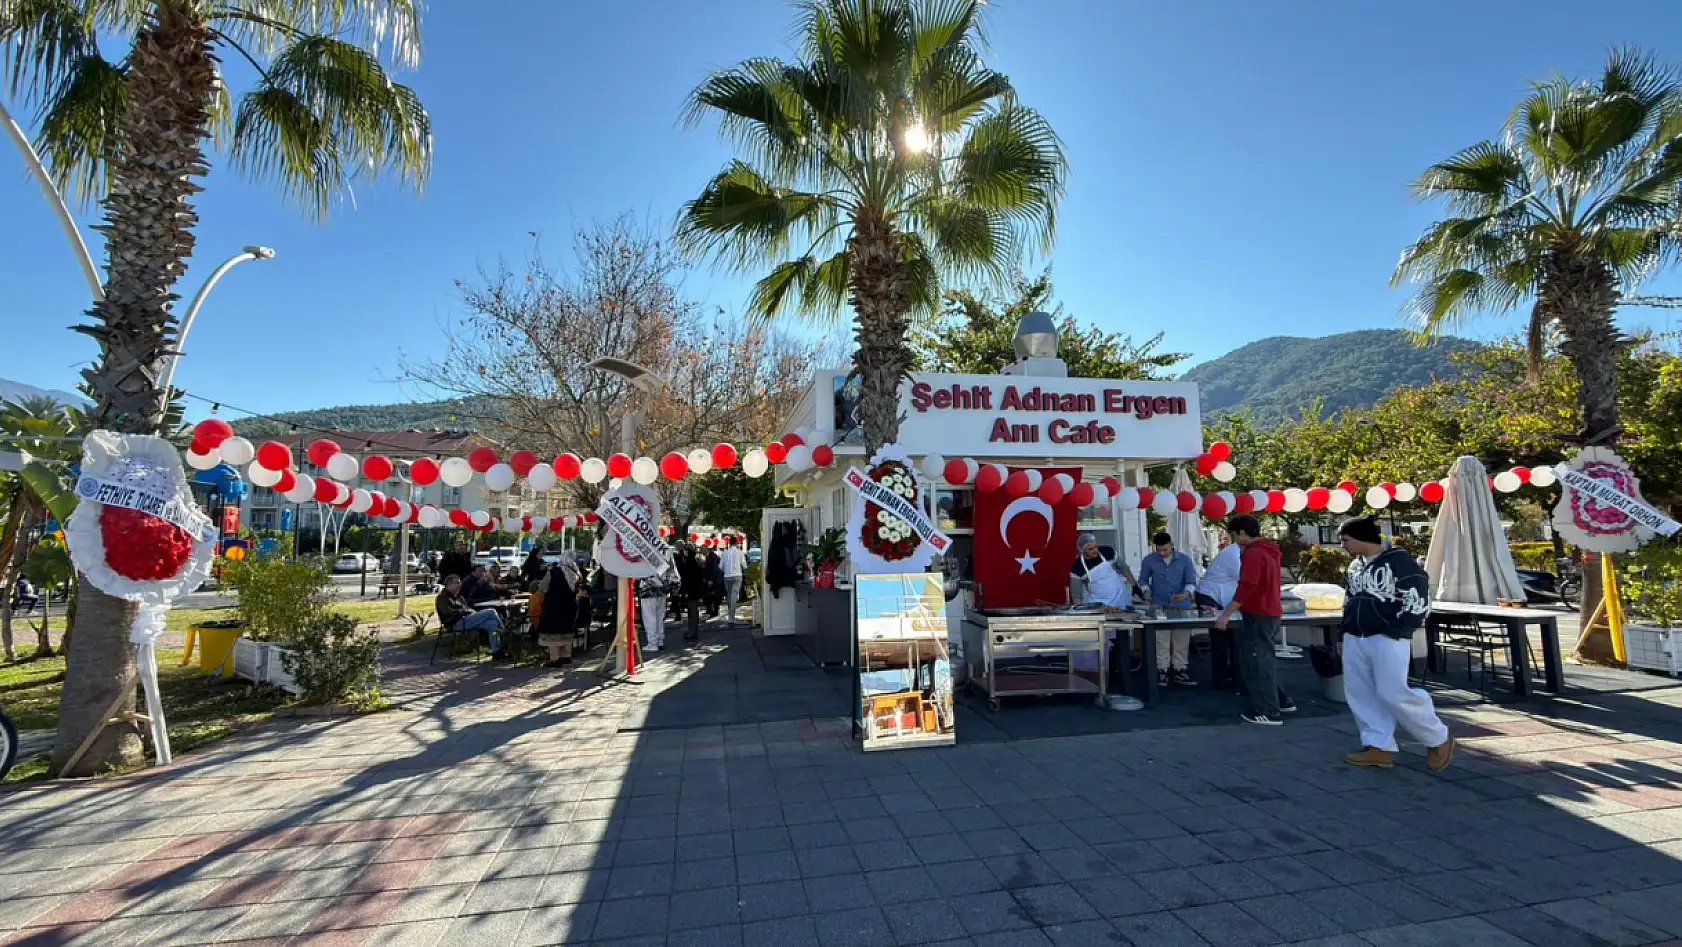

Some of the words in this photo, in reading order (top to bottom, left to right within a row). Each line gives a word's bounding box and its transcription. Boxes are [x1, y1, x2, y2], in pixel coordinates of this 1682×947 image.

[911, 382, 992, 413] Şehit
[1000, 385, 1095, 412] Adnan
[1104, 388, 1187, 420] Ergen
[989, 417, 1040, 443] Anı
[1047, 418, 1116, 444] Cafe
[1562, 471, 1599, 494] KAPTAN
[1597, 487, 1632, 509] MURAT
[1629, 504, 1664, 529] ORHON
